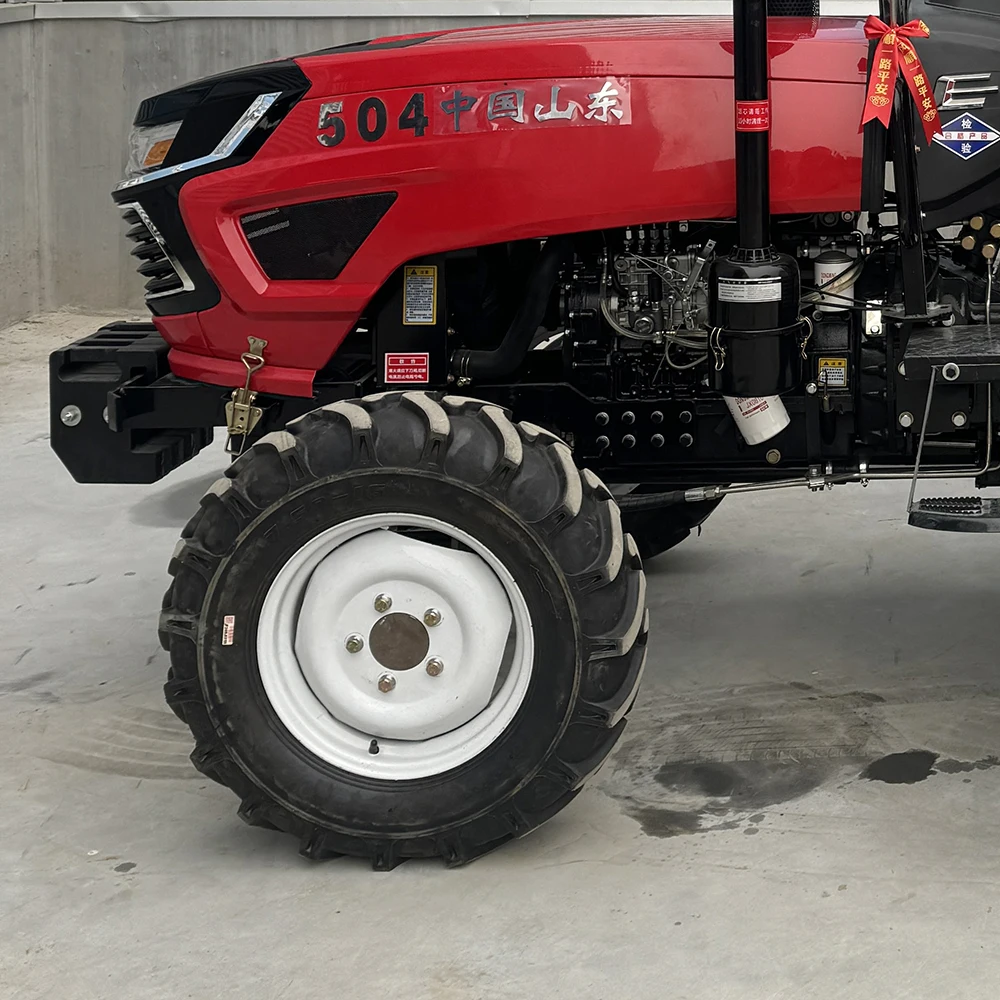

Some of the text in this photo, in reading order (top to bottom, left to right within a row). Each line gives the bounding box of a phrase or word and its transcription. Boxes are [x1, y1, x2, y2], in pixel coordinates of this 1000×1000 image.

[316, 81, 624, 147] 504 中国山东
[961, 118, 972, 130] 检
